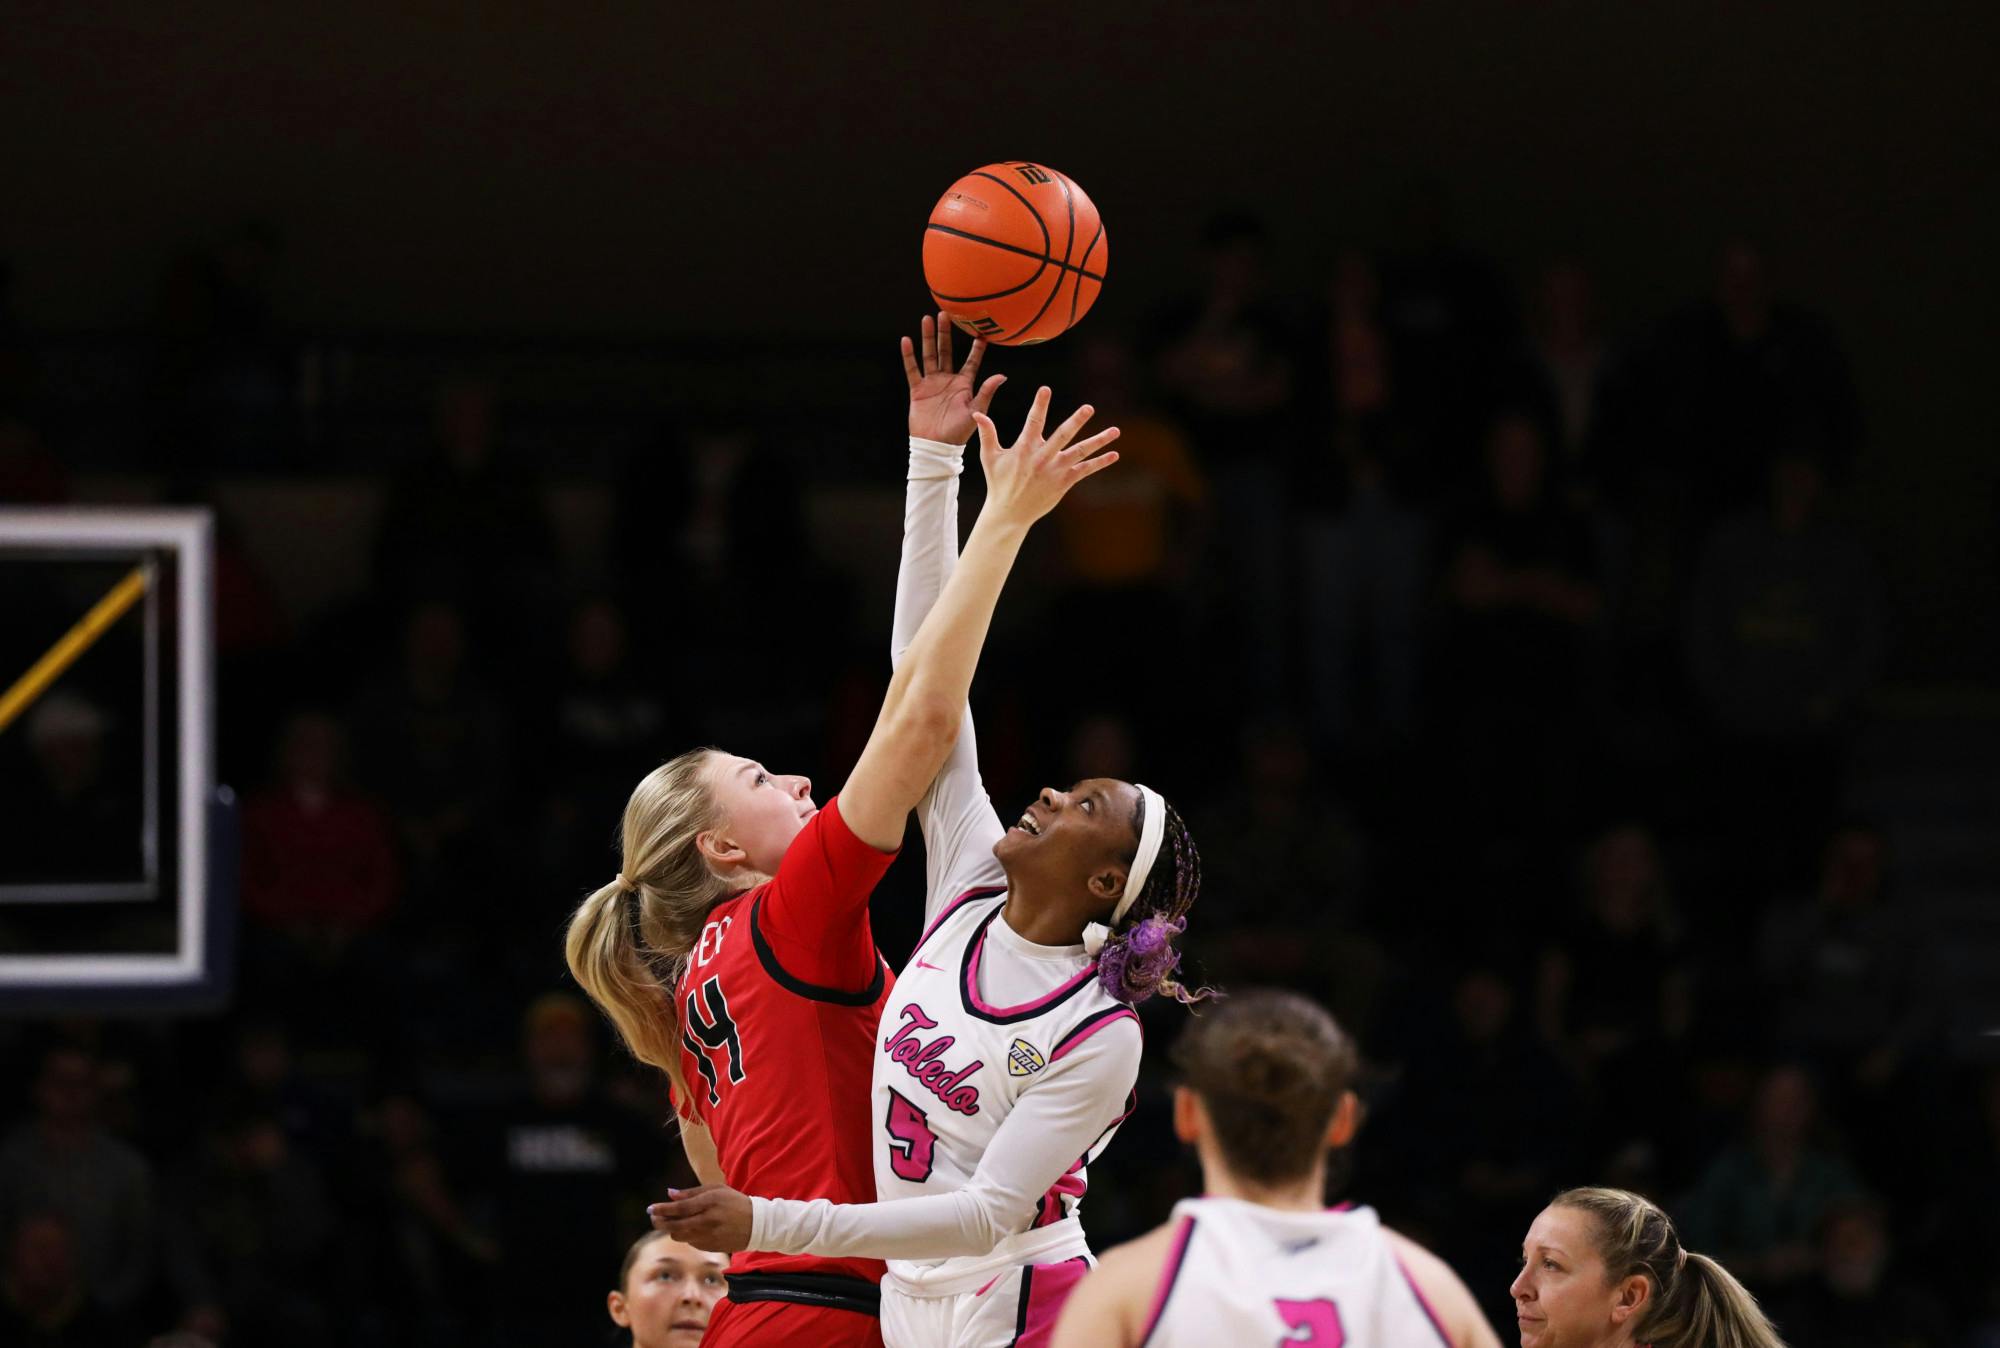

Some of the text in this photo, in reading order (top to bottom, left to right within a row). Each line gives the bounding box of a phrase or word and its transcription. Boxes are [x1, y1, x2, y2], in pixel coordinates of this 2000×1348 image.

[682, 974, 746, 1108] 14
[884, 1003, 984, 1116] Toledo
[885, 1085, 939, 1183] 5
